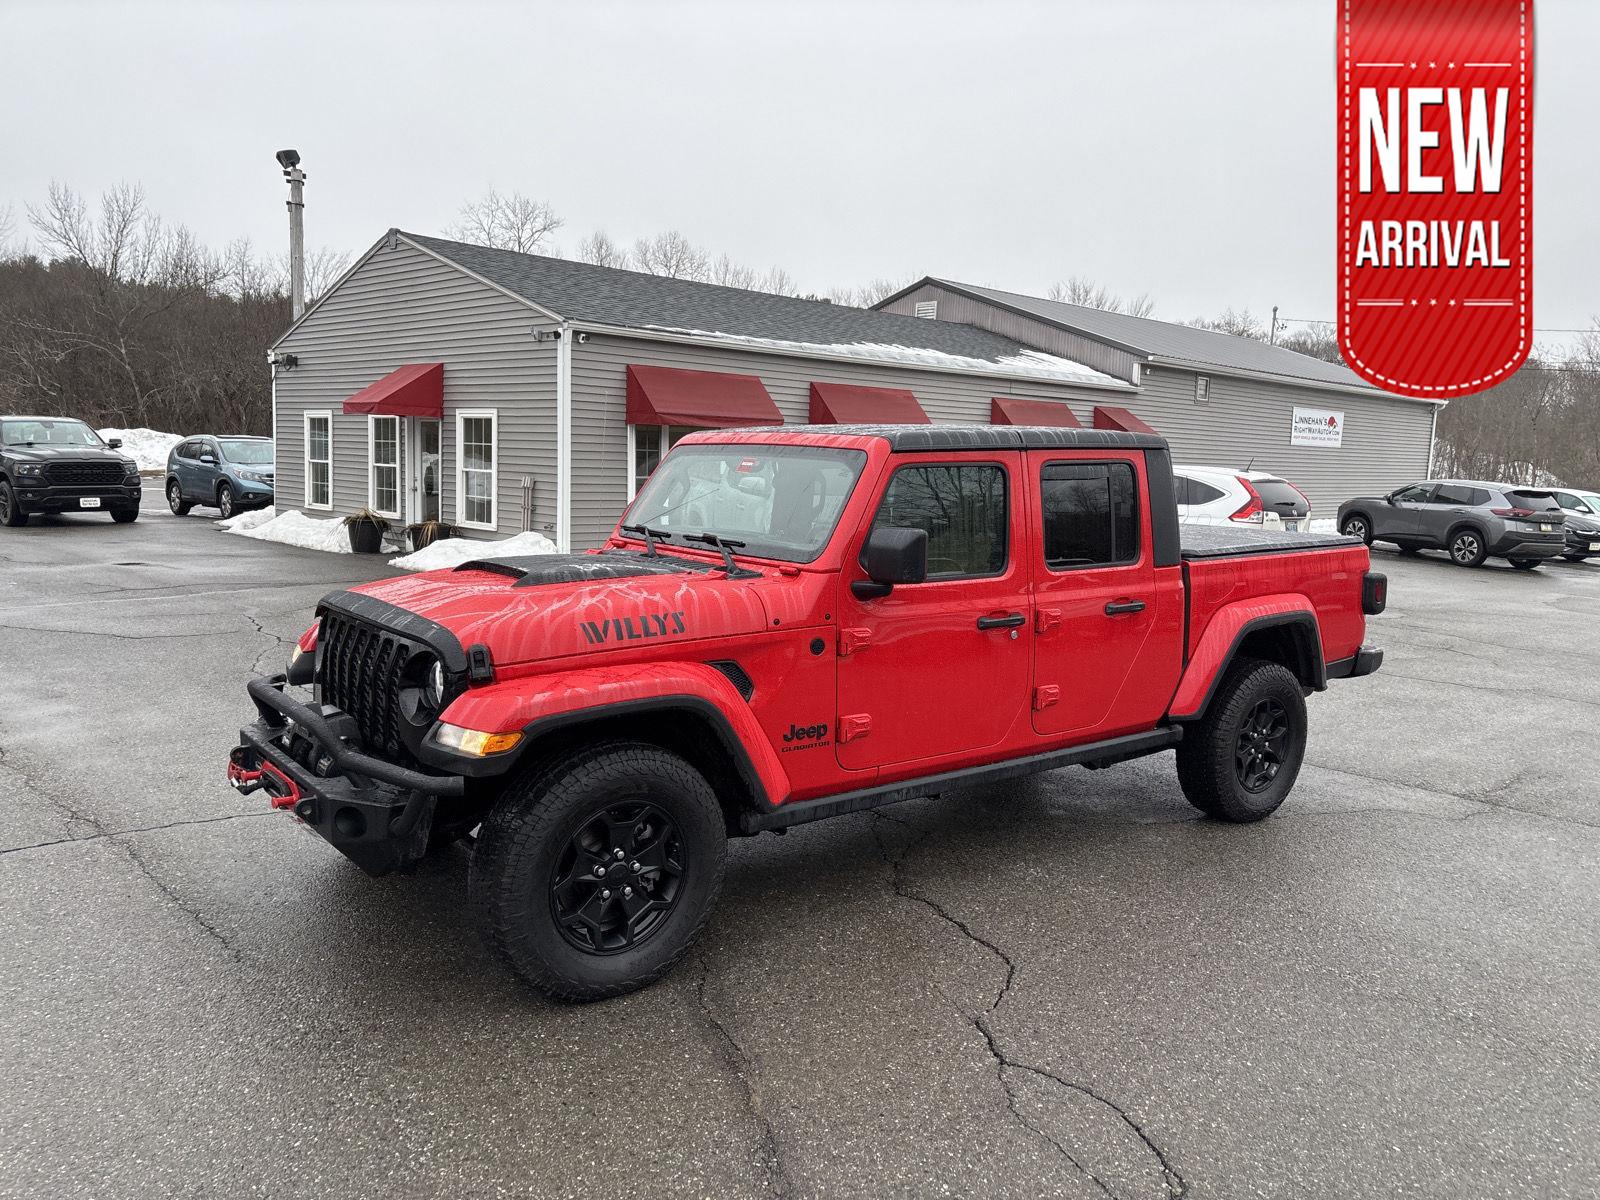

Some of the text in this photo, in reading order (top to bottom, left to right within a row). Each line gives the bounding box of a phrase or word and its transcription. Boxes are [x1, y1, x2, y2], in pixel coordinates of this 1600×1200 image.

[580, 611, 685, 644] WILLYS
[782, 722, 828, 742] Jeep
[781, 740, 831, 753] GLADIATOR
